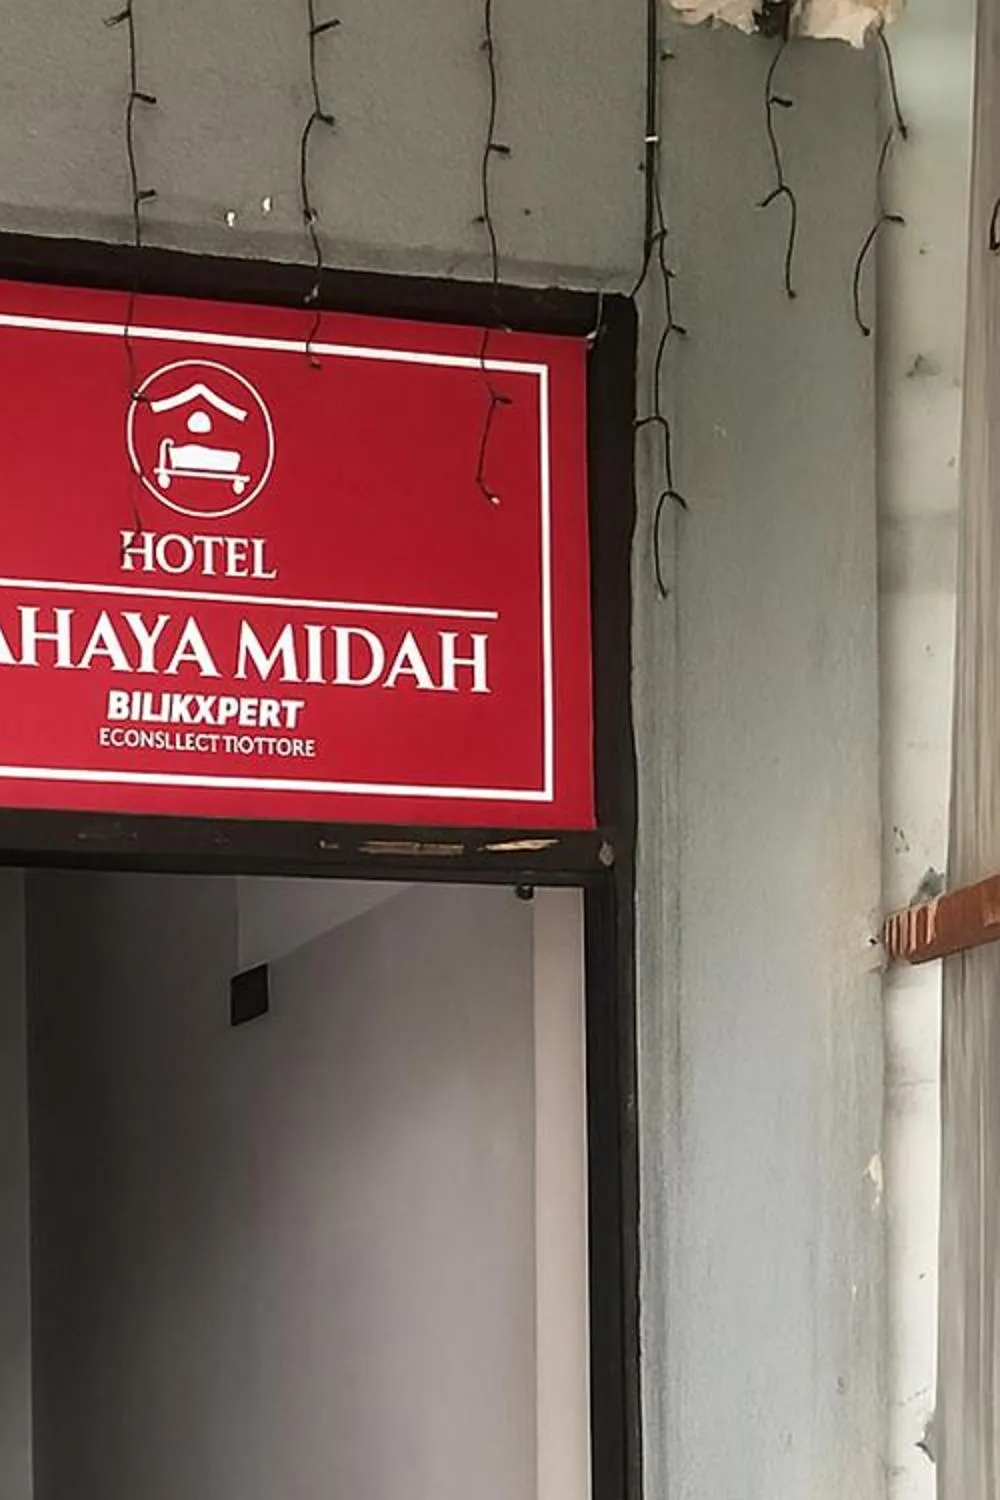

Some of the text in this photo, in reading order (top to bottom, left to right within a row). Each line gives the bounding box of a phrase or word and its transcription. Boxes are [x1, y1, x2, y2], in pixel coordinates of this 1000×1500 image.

[119, 530, 278, 580] HOTEL
[234, 619, 492, 694] MIDAH
[107, 689, 305, 729] BILIKXPERT
